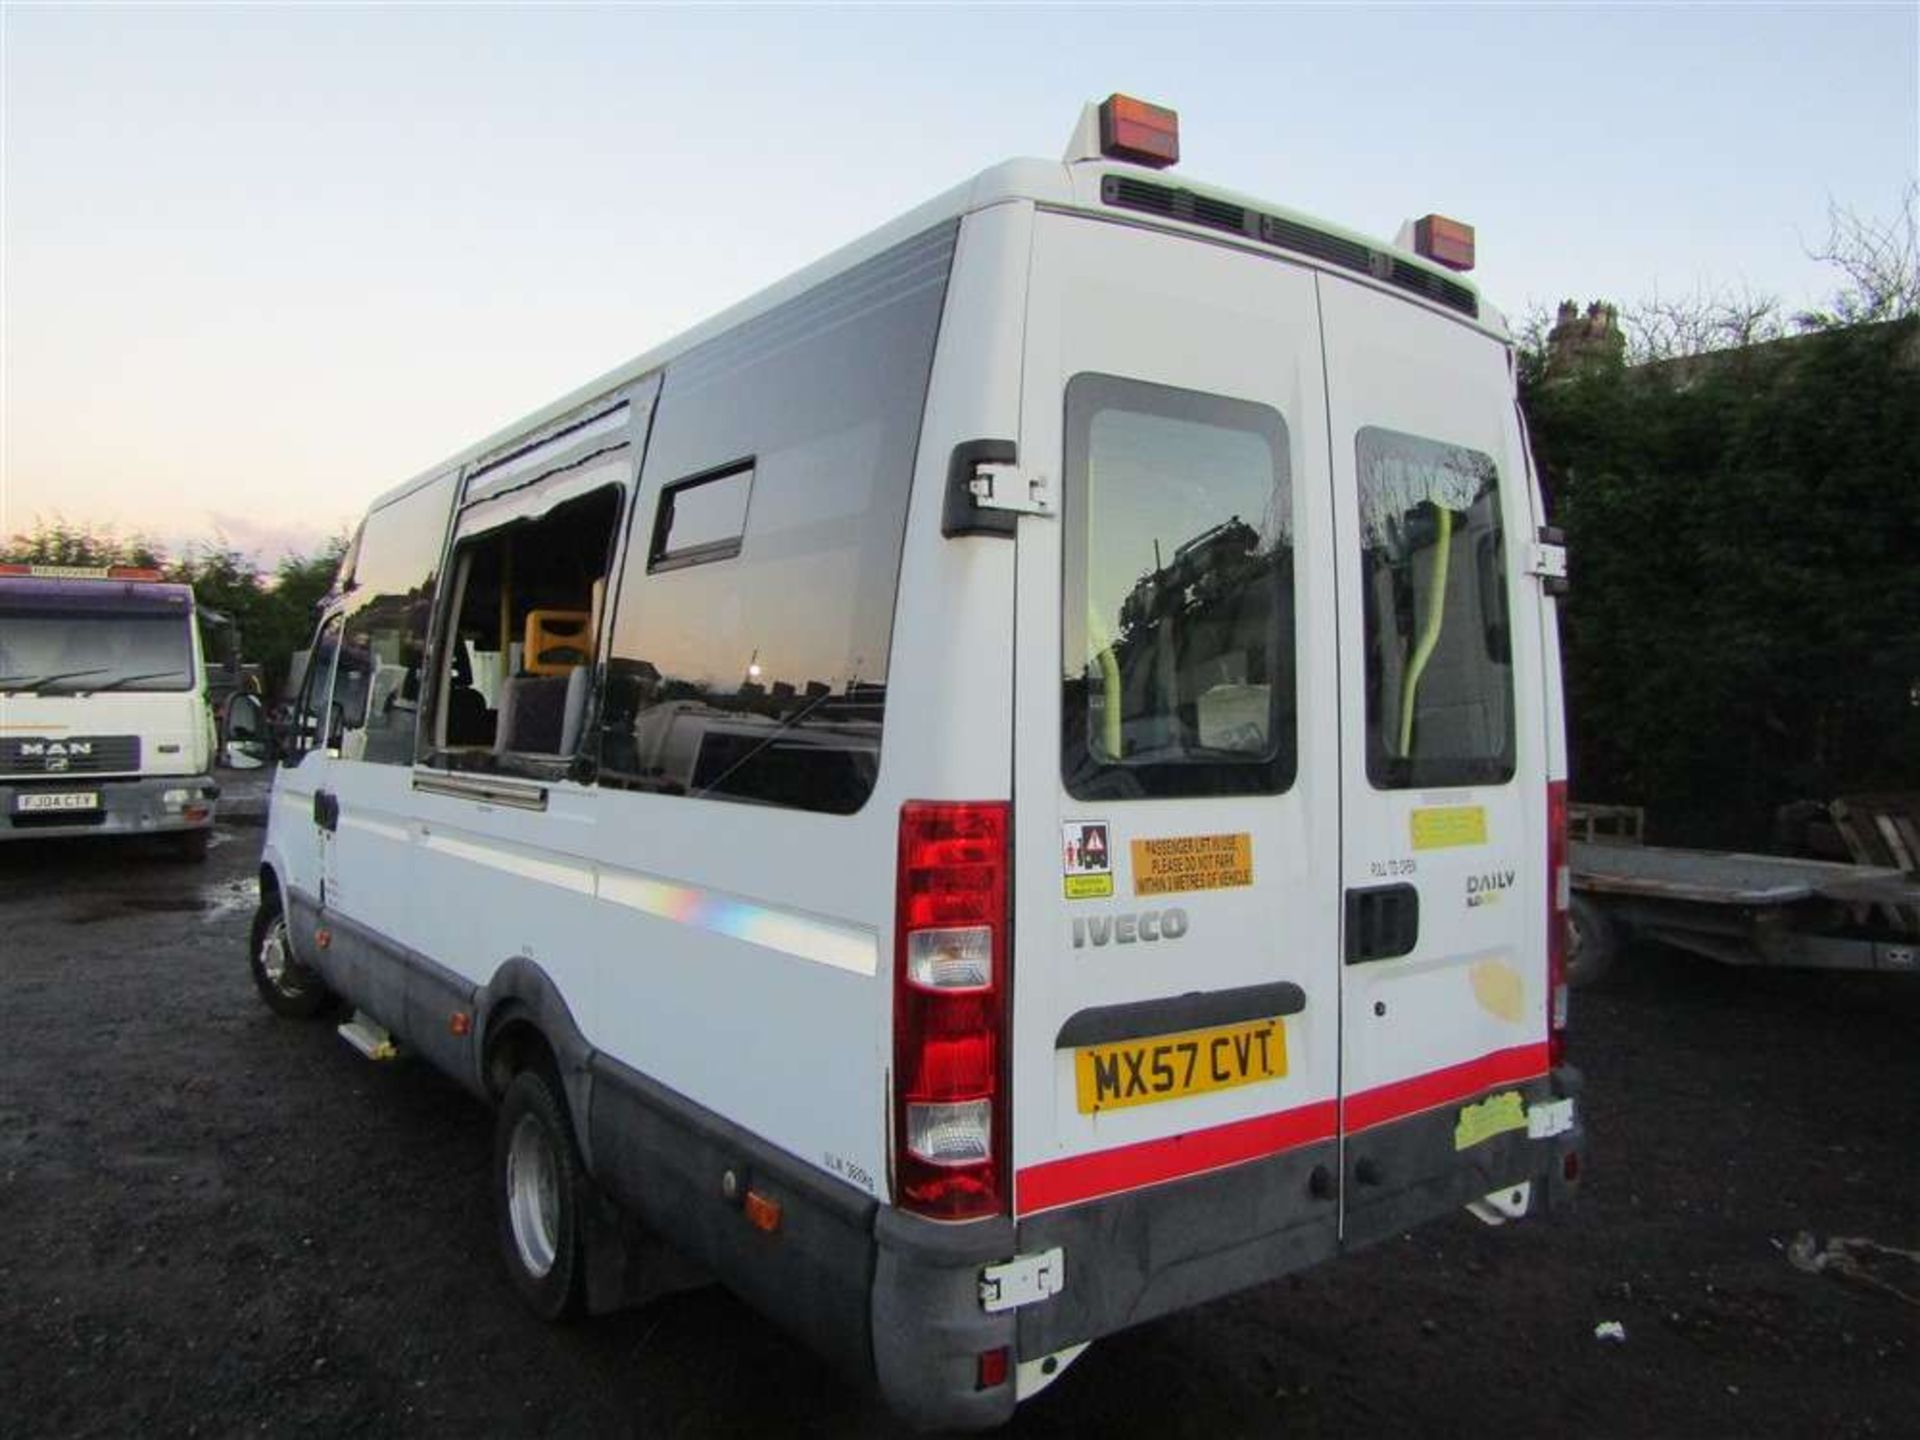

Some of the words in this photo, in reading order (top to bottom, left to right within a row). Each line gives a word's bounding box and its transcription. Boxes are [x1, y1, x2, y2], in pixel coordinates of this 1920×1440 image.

[20, 743, 92, 755] MAN
[64, 793, 91, 807] CTY
[1145, 838, 1193, 855] PASSENGER
[1151, 856, 1183, 874] PLEASE
[1185, 854, 1197, 871] DO
[1215, 851, 1235, 867] PARK
[1219, 868, 1252, 886] VEHICLE
[1073, 908, 1188, 948] IVECO
[1094, 1042, 1198, 1102] MX57
[1211, 1029, 1272, 1082] CVT
